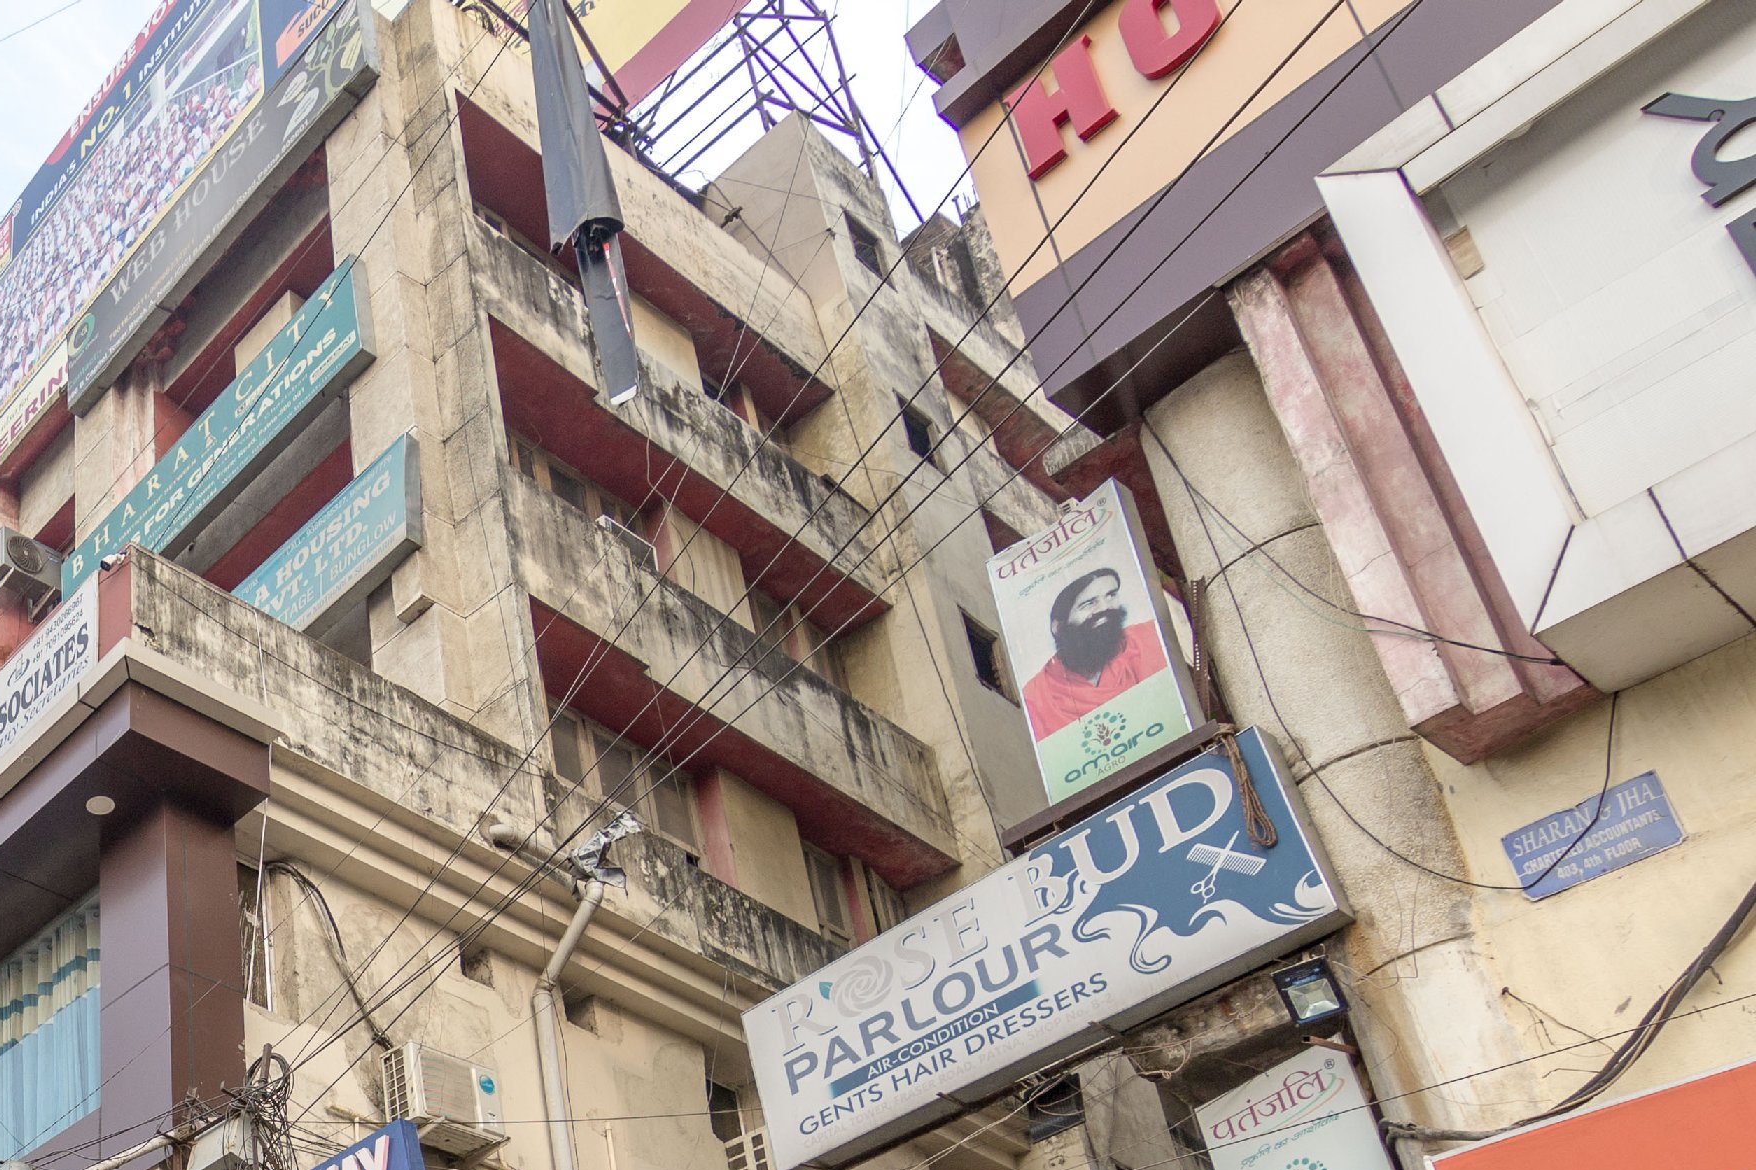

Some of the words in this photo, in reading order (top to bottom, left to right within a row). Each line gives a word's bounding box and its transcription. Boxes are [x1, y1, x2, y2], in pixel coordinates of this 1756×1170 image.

[70, 40, 137, 138] ENSURE
[31, 158, 75, 226] INDIA'S
[80, 95, 119, 161] NO.
[123, 78, 130, 103] 1
[111, 222, 165, 310] WEB
[174, 102, 266, 234] HOUSE
[72, 409, 215, 579] BHARAT
[235, 278, 338, 406] CITY
[143, 483, 183, 537] FOR
[187, 325, 336, 492] GENERATIONS
[275, 467, 389, 589] HOUSING
[314, 510, 368, 578] LTD.
[330, 508, 396, 582] BUNGLOW
[995, 498, 1099, 586] पतंजलि
[21, 650, 89, 729] Secretaries
[1096, 754, 1126, 777] AGRO
[1007, 753, 1245, 929] BUD
[1508, 807, 1594, 858] SHARAN
[1595, 804, 1614, 821] &
[1613, 780, 1657, 817] JHA
[1520, 839, 1585, 876] CHARTERED
[1583, 807, 1662, 849] ACCOUNTANTS
[1581, 852, 1603, 870] 4th
[1603, 835, 1643, 861] FLOOR
[783, 918, 1070, 1096] PARLOUR
[864, 1000, 1001, 1080] AIR-CONDITION
[797, 1079, 884, 1139] GENTS
[889, 1044, 958, 1093] HAIR
[963, 969, 1110, 1057] DRESSERS
[1207, 1061, 1330, 1145] पतंजलि
